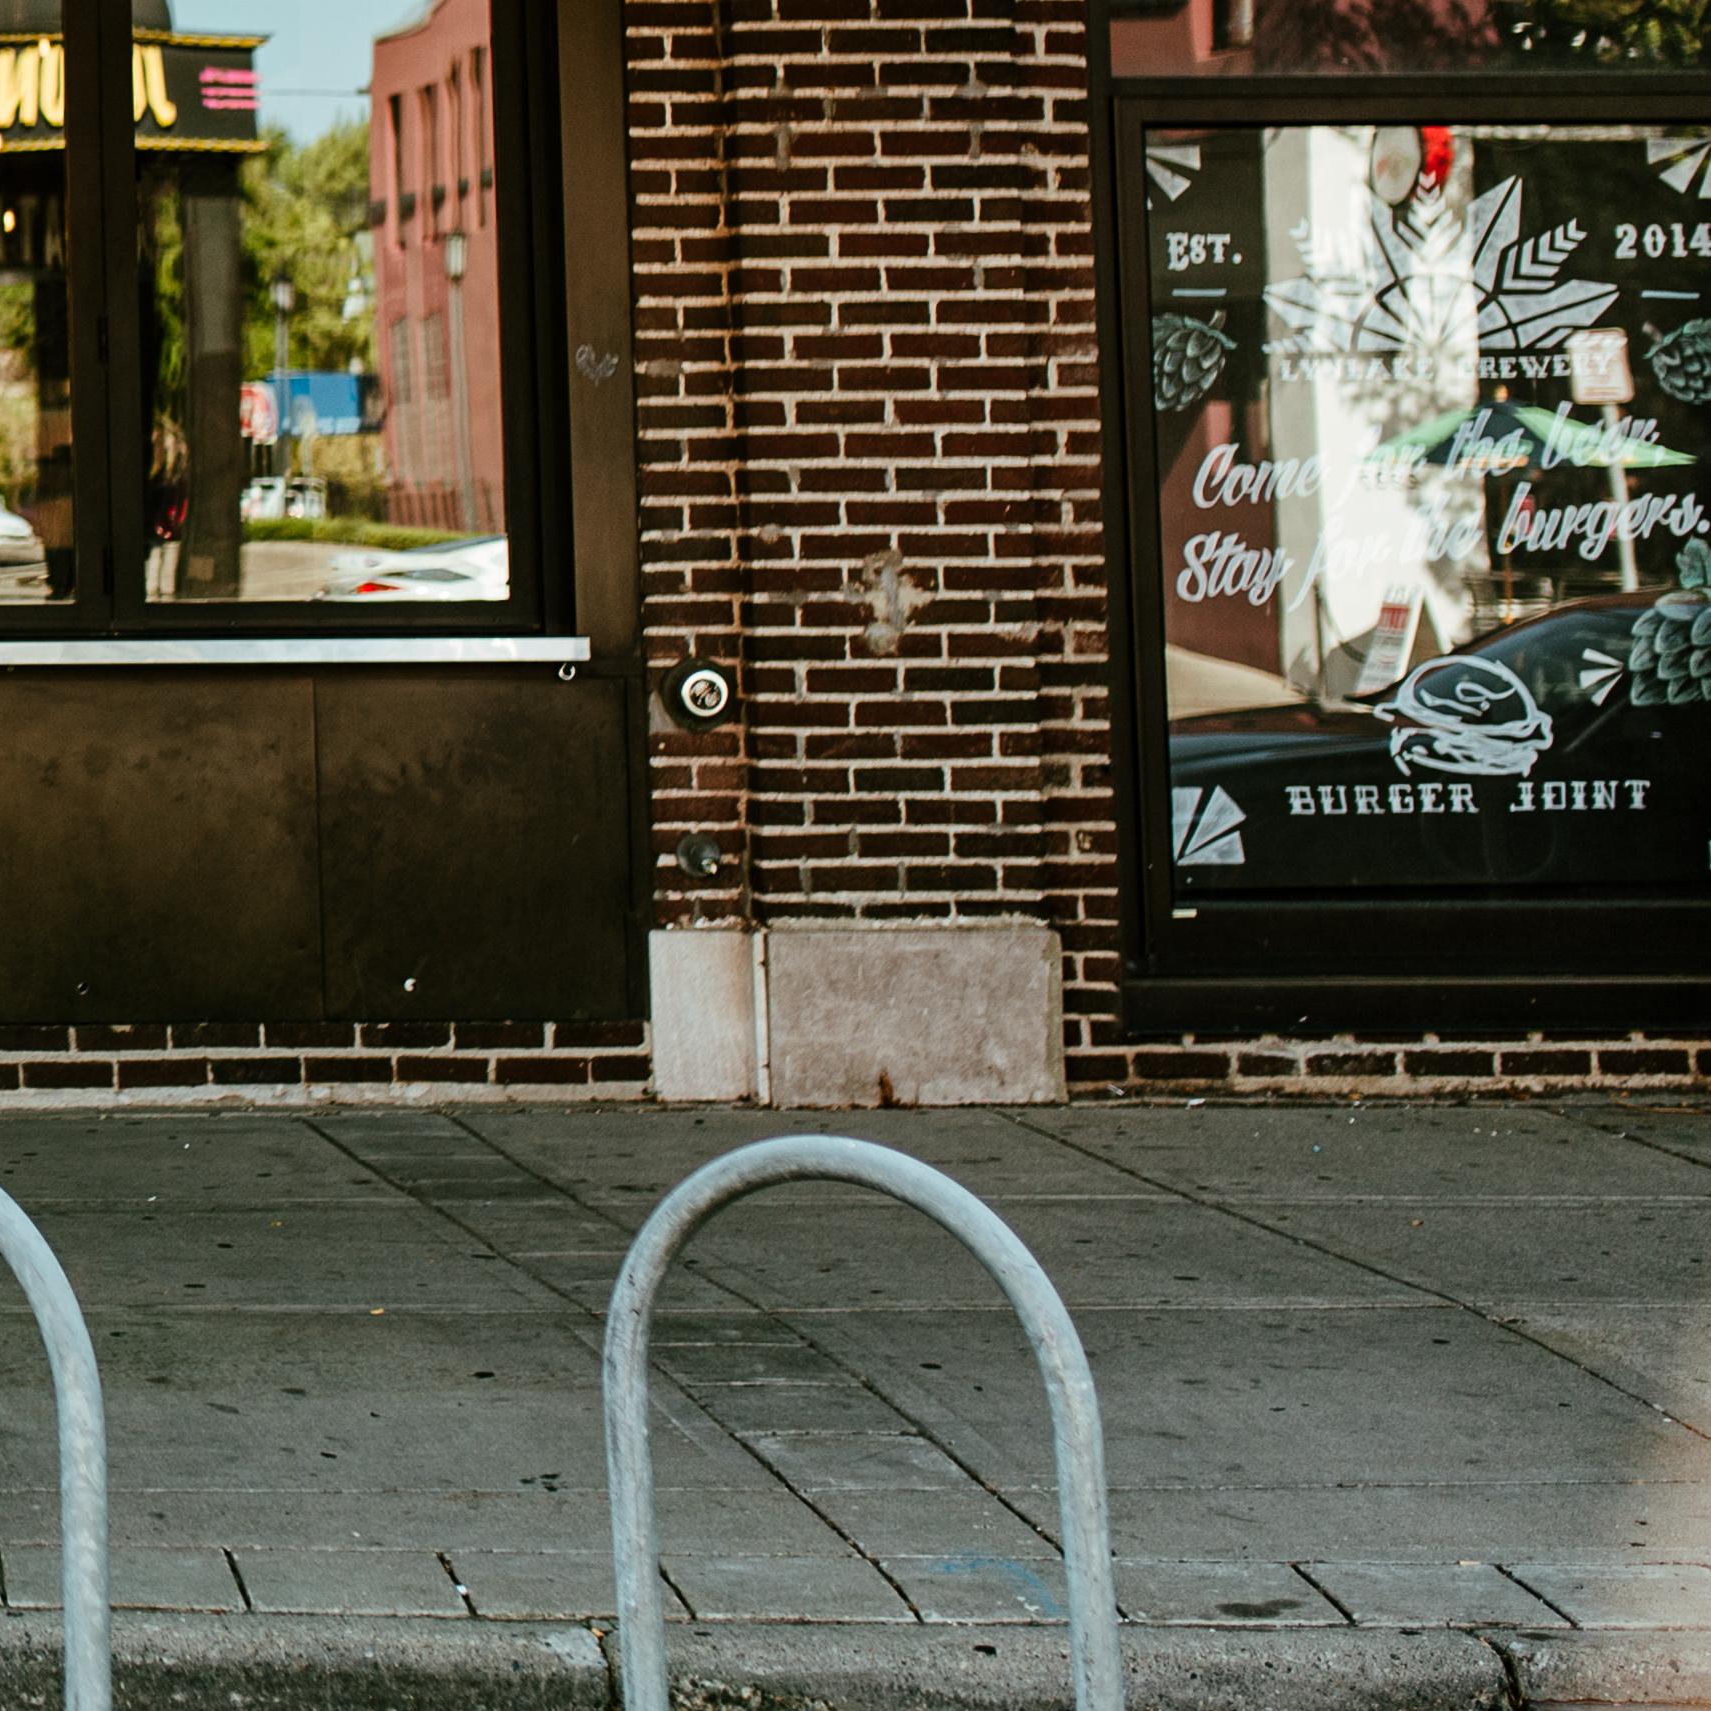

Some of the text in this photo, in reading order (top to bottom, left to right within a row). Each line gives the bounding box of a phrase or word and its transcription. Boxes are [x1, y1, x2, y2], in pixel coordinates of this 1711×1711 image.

[1166, 231, 1243, 272] EST.
[1615, 222, 1711, 260] 2014
[1279, 350, 1615, 382] LYNLAKE BREWERY
[1192, 442, 1329, 510] Come
[1442, 407, 1526, 481] the
[1175, 480, 1711, 614] Stay for the burgers.
[1285, 778, 1651, 816] BURGER JOINT
